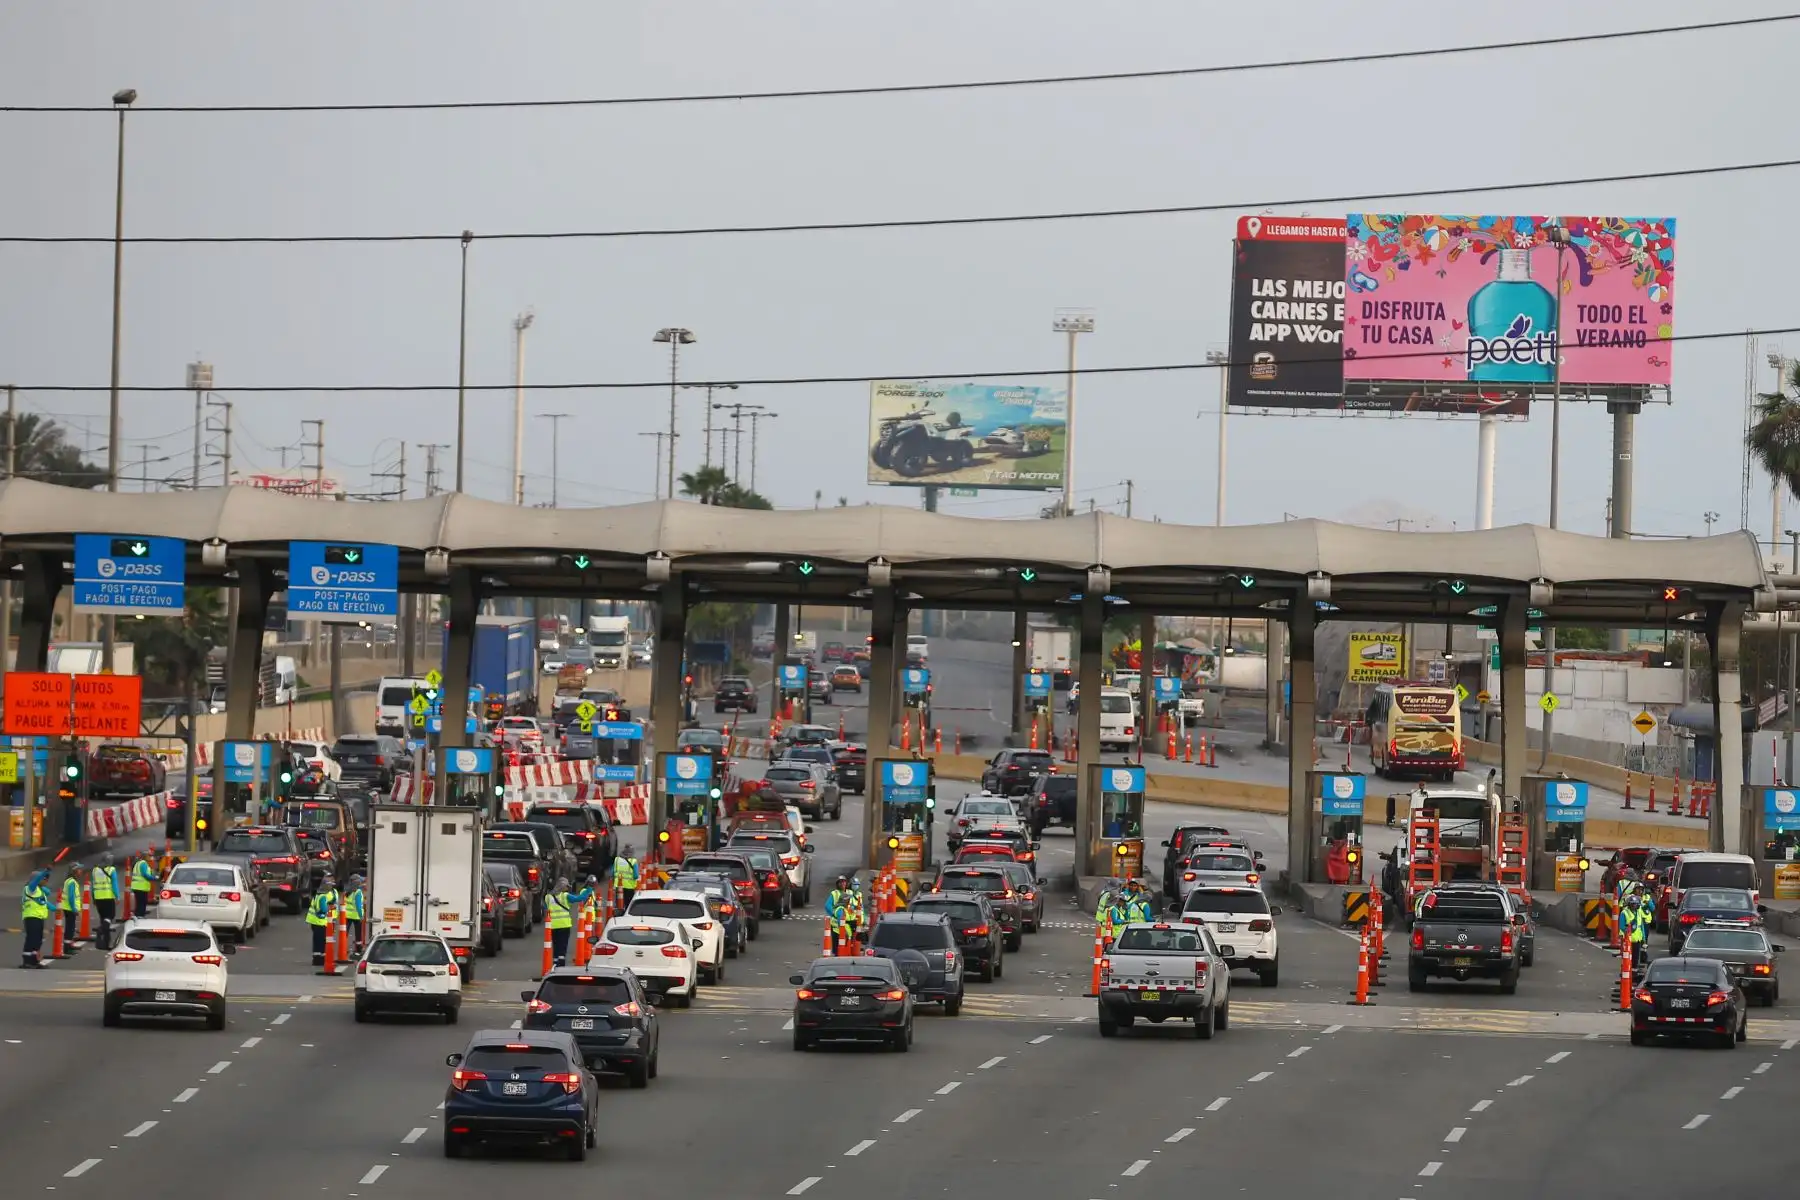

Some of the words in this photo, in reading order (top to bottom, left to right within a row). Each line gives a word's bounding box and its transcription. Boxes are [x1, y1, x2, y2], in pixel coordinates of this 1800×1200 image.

[1266, 224, 1310, 236] LLEGAMOS
[1311, 226, 1338, 237] HASTA
[1251, 278, 1287, 298] LAS
[1292, 279, 1345, 299] MEJO
[1250, 300, 1328, 321] CARNES
[1362, 300, 1446, 321] DISFRUTA
[1577, 304, 1622, 324] TODO
[1628, 305, 1648, 324] EL
[1249, 322, 1291, 342] APP
[1361, 324, 1382, 344] TU
[1388, 325, 1434, 345] CASA
[1576, 328, 1647, 349] VERANO
[1467, 332, 1557, 370] poett
[877, 389, 916, 397] FORGE
[1019, 472, 1060, 480] MOTOR
[99, 560, 162, 577] e-pass
[312, 567, 376, 585] e-pass
[101, 583, 157, 595] POST-PAGO
[314, 590, 370, 601] POST-PAGO
[85, 593, 110, 603] PAGO
[114, 594, 126, 604] EN
[129, 595, 173, 605] EFECTIVO
[299, 600, 323, 610] PAGO
[327, 601, 339, 611] EN
[343, 602, 385, 613] EFECTIVO
[1351, 634, 1407, 642] BALANZA
[1354, 668, 1406, 676] ENTRADA
[32, 680, 62, 693] SOLO
[74, 681, 114, 695] AUTOS
[15, 699, 50, 709] ALTURA
[15, 714, 54, 728] PAGUE
[61, 716, 128, 731] ADELANTE
[1111, 978, 1194, 986] RANGER
